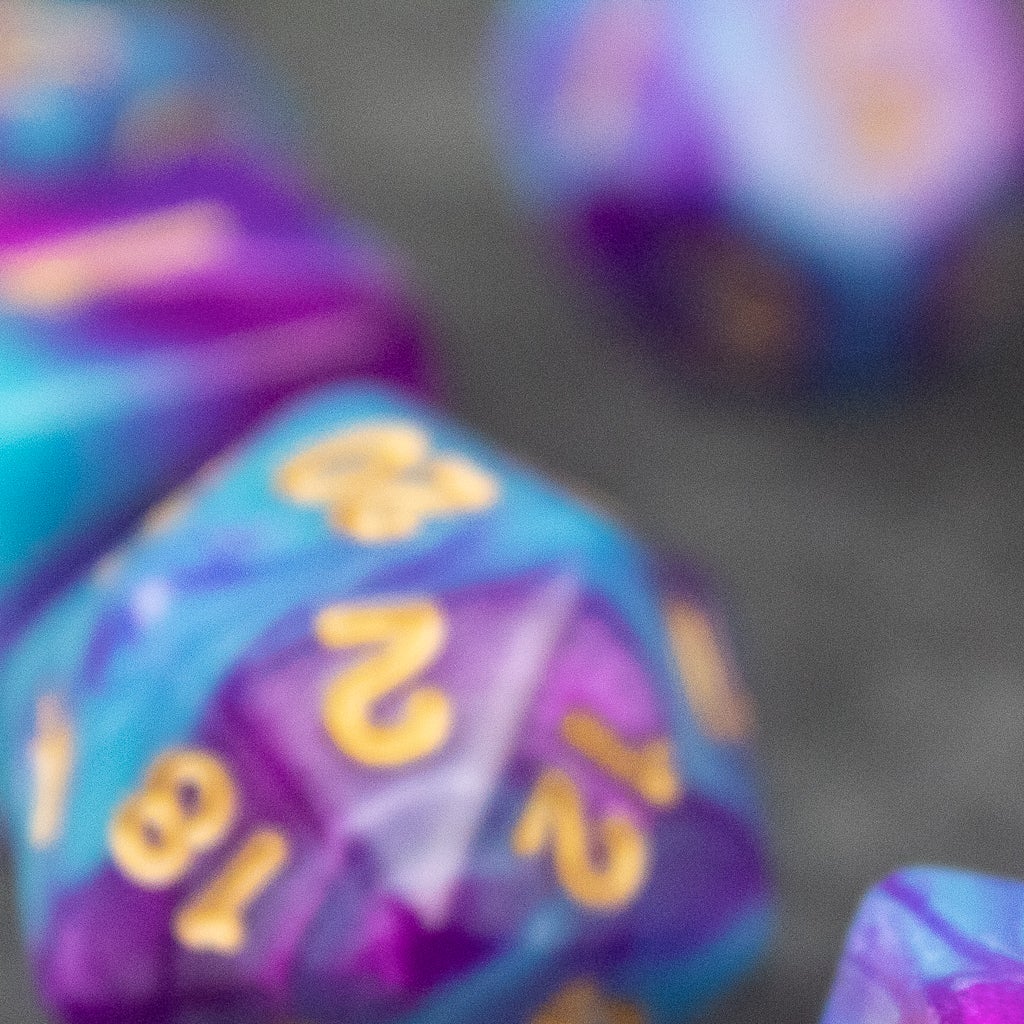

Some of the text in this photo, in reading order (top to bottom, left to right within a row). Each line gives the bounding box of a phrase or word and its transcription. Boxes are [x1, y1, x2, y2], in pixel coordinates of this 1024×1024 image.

[314, 598, 452, 768] 2
[108, 748, 290, 956] 18
[511, 705, 682, 914] 12
